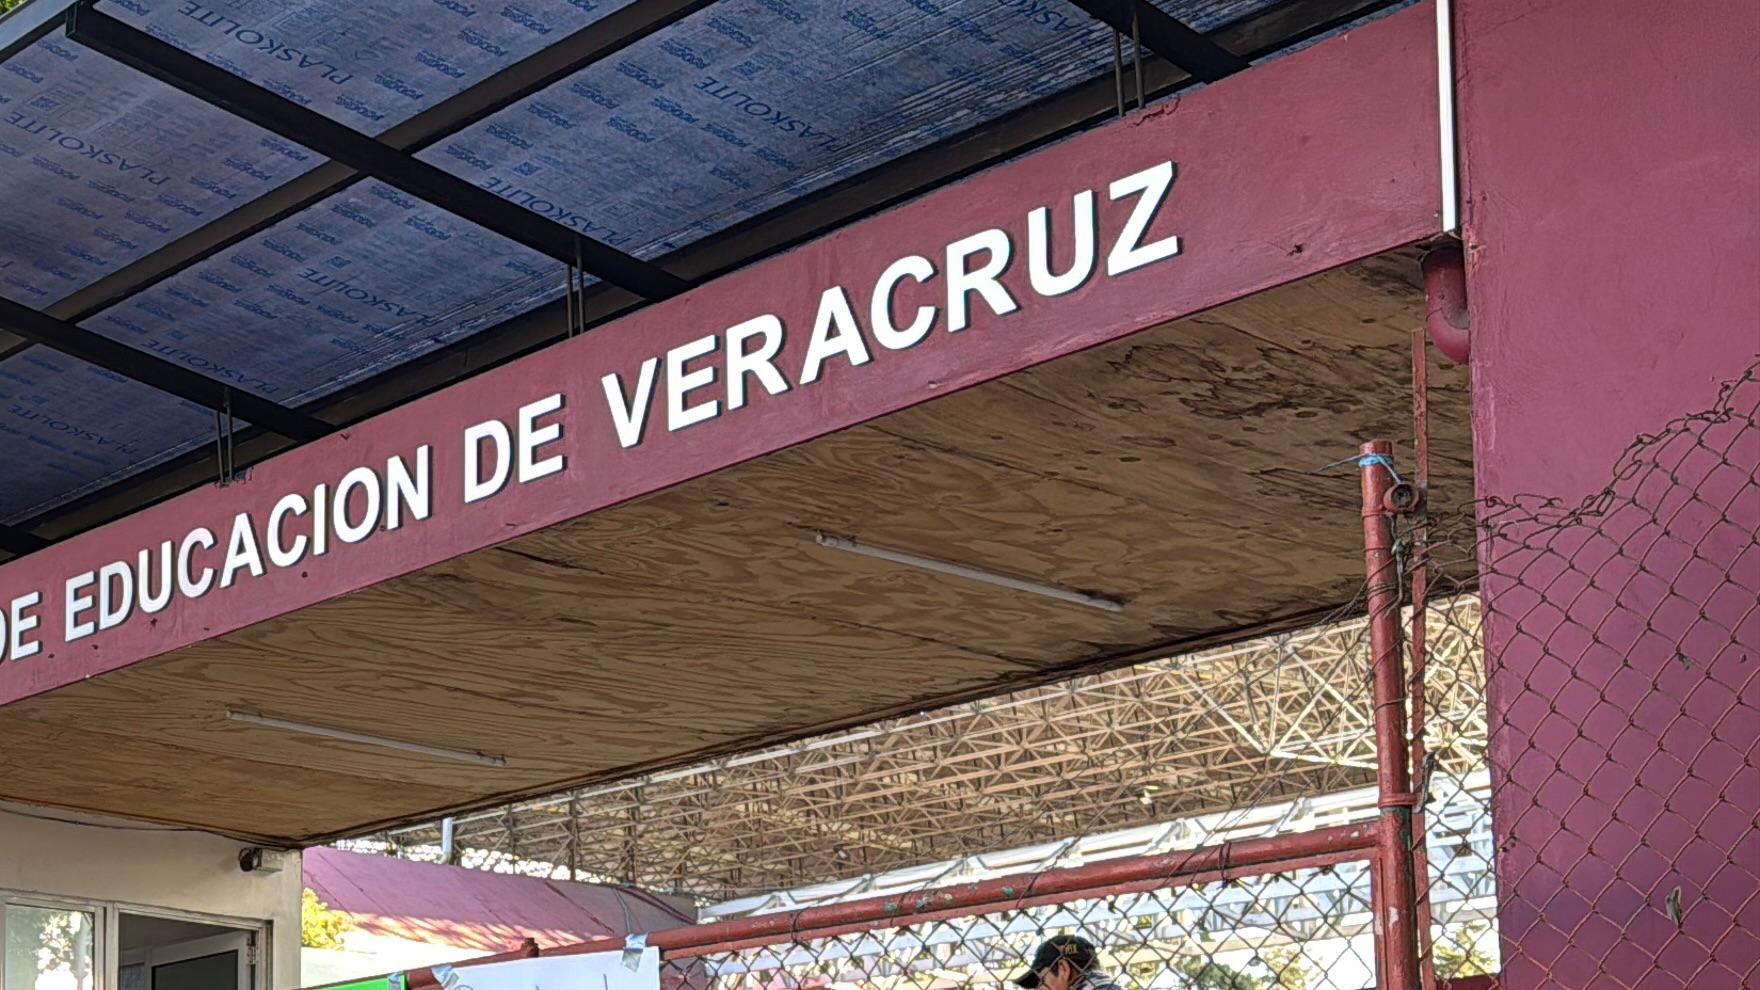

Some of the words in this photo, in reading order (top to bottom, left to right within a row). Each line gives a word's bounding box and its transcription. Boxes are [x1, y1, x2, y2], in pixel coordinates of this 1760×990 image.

[178, 0, 351, 86] PLASKOLITE
[4, 111, 172, 186] PLASKOLITE
[480, 176, 632, 247] PLASKOLITE
[65, 444, 431, 643] EDUCACION
[464, 393, 565, 503] DE
[601, 161, 1180, 449] VERACRUZ
[140, 339, 282, 394] PLASKOLITE
[7, 403, 140, 455] PLASKOLITE
